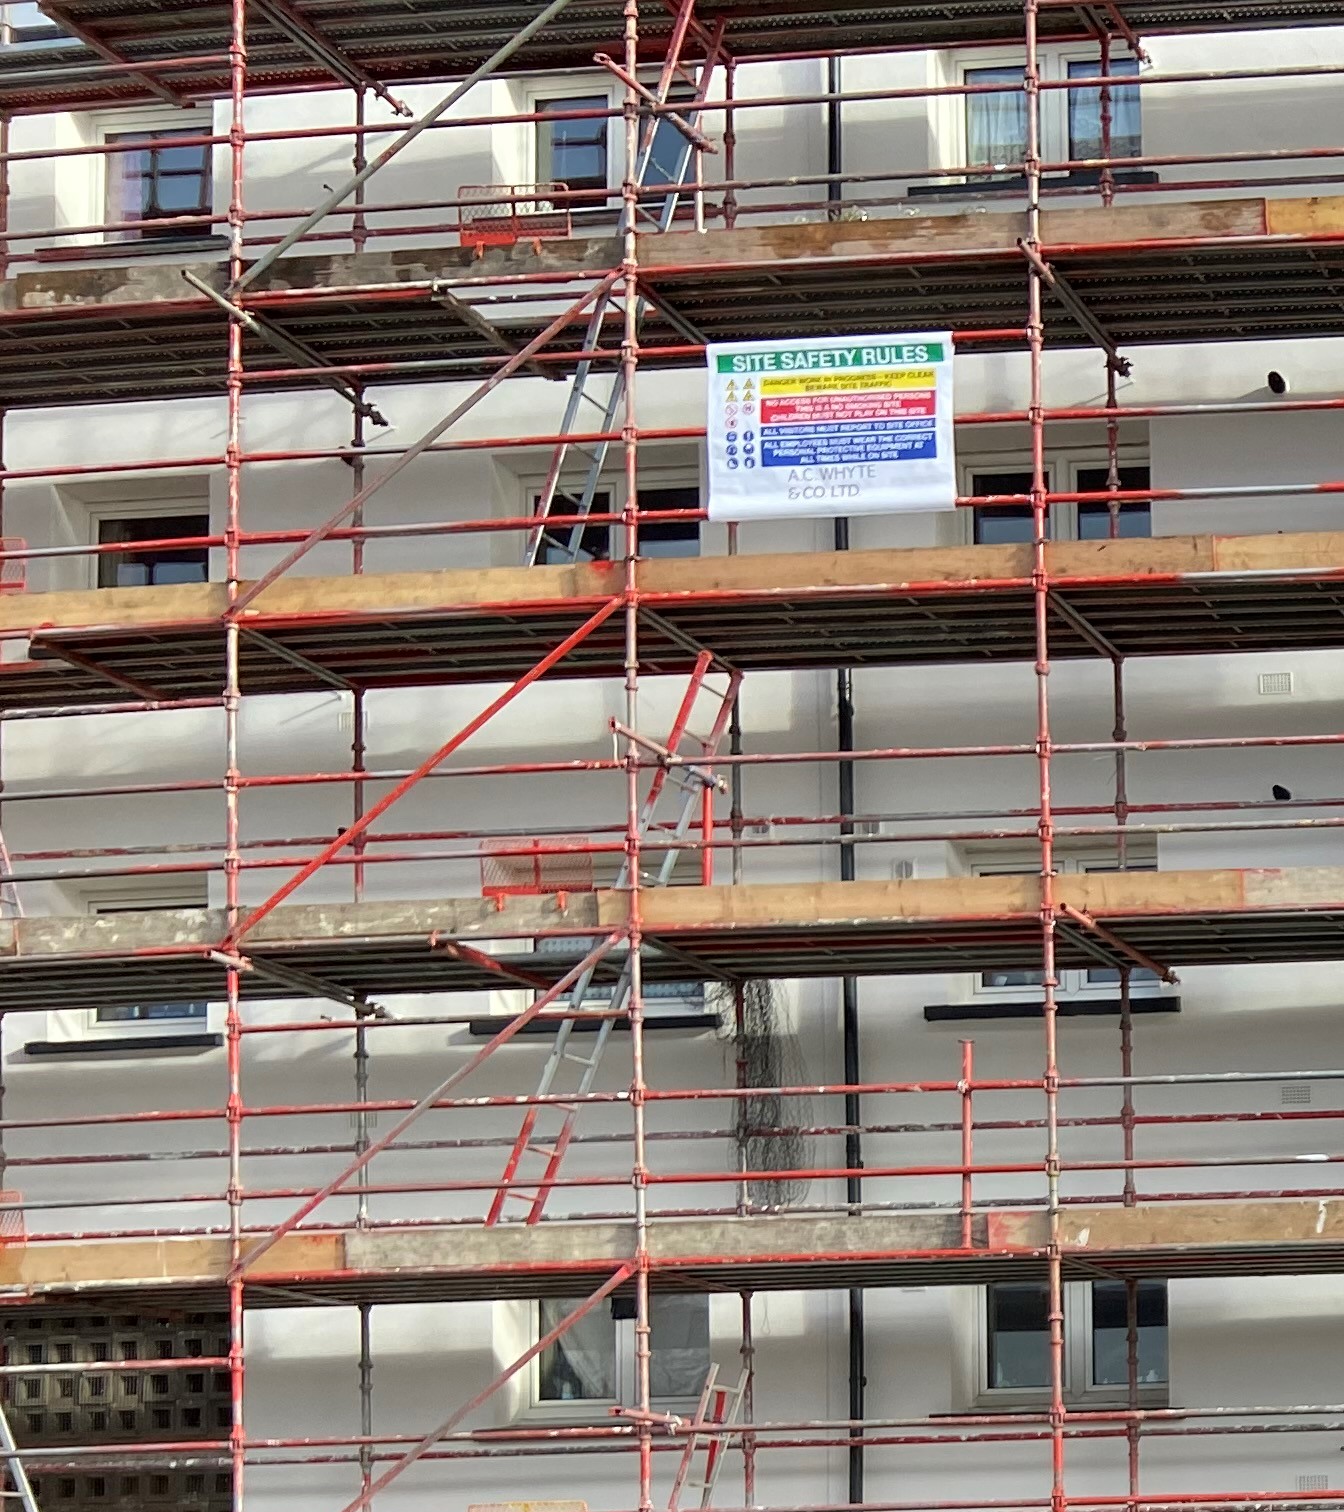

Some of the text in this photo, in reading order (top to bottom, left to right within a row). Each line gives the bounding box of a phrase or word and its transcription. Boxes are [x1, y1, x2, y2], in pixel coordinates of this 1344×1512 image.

[732, 346, 928, 372] SITE SAFETY RULES
[819, 464, 876, 480] WHYTE
[788, 487, 801, 500] &
